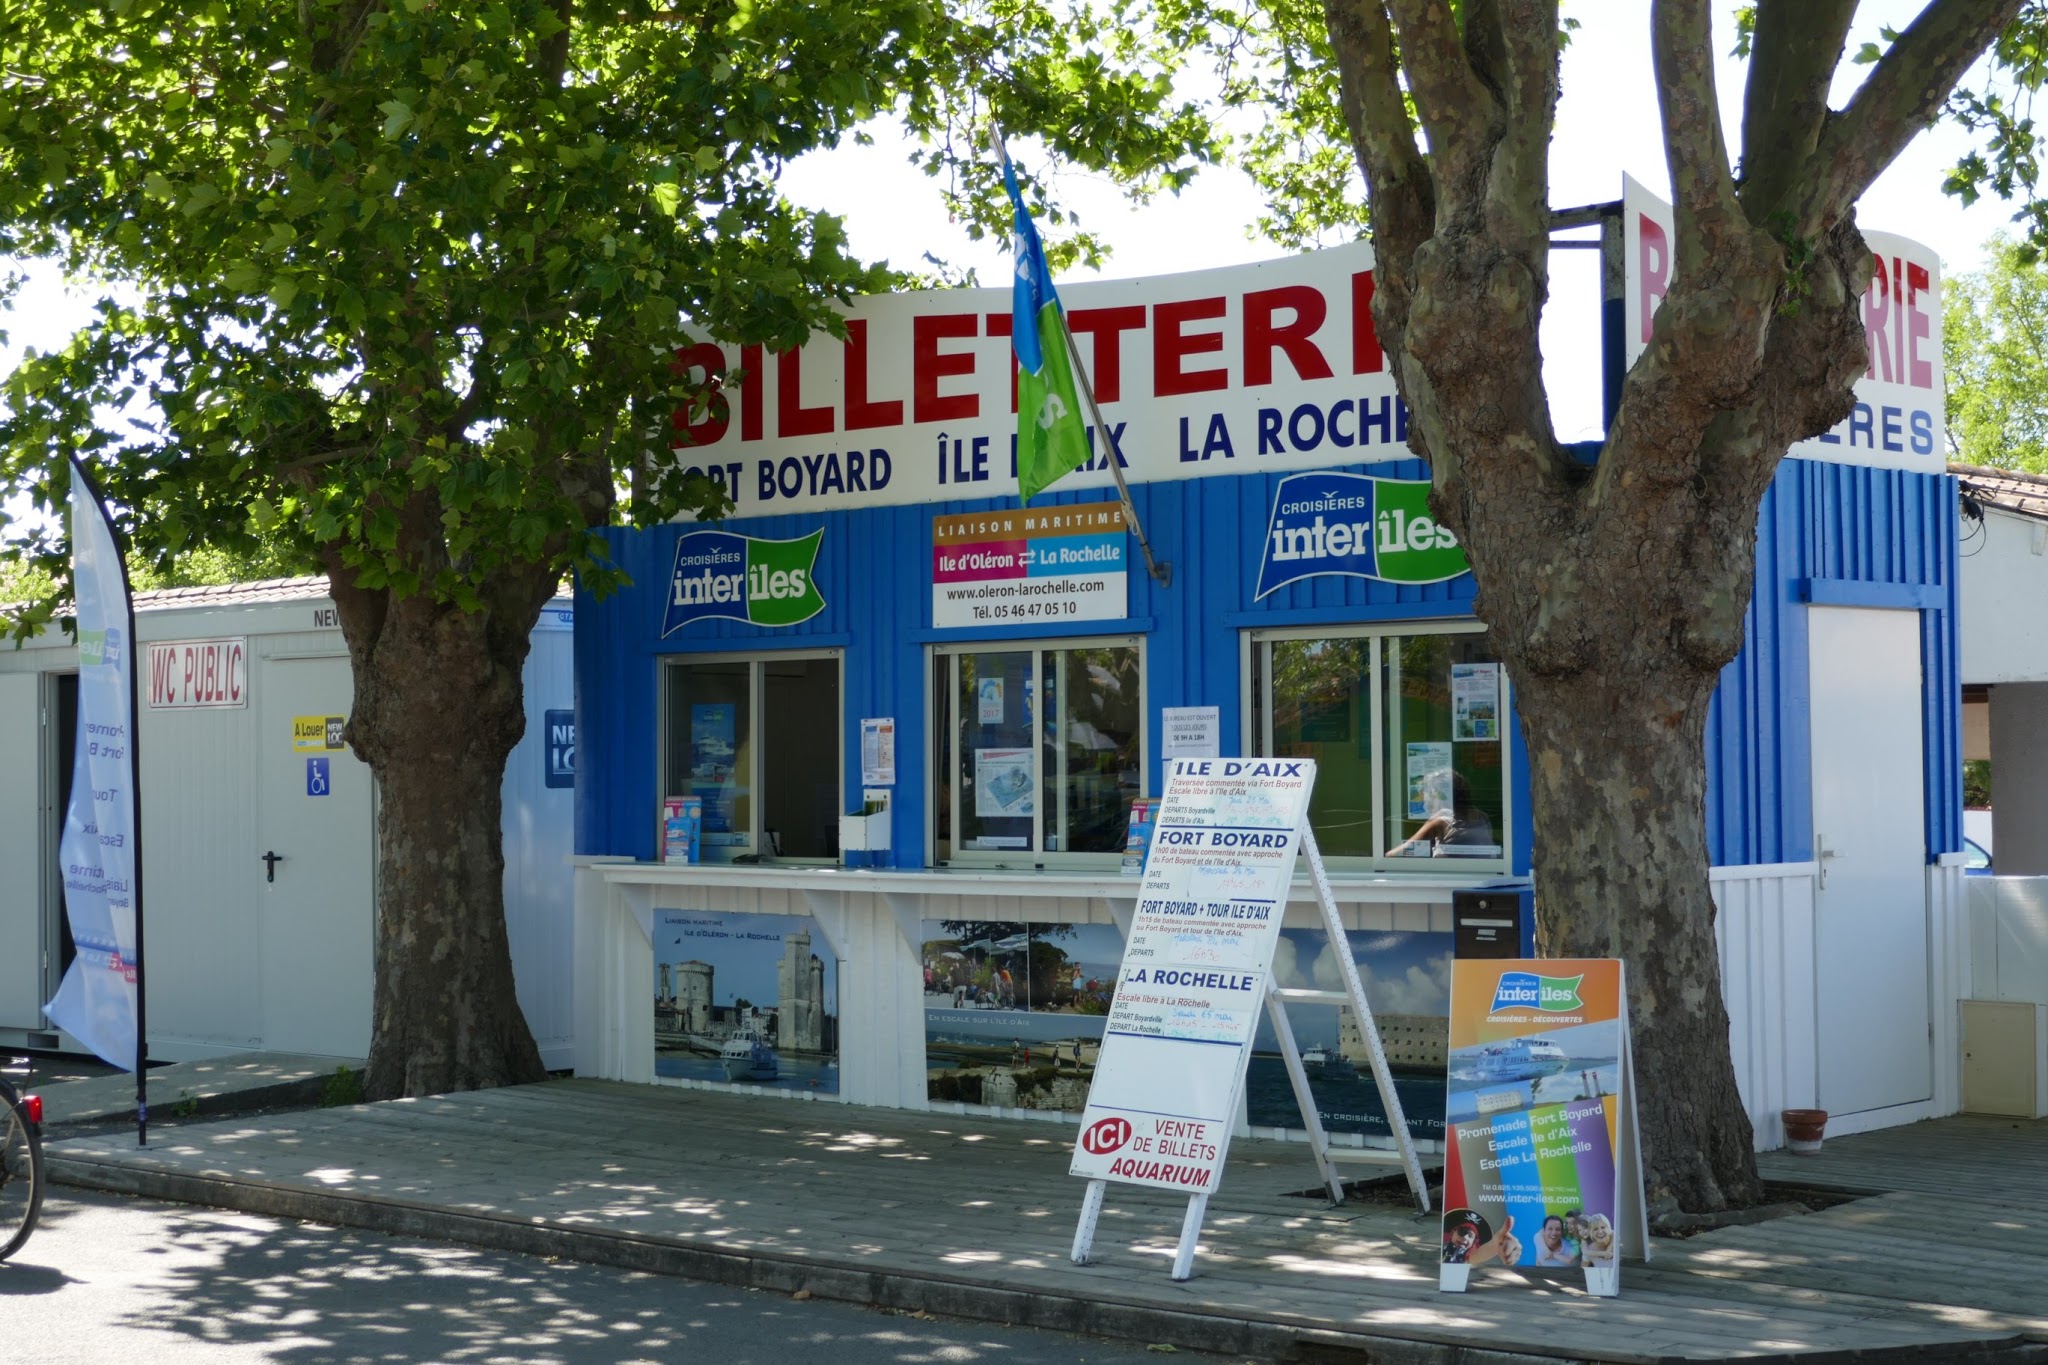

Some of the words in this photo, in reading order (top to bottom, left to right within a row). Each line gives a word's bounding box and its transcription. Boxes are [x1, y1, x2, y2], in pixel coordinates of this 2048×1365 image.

[1180, 413, 1235, 463] LA
[937, 431, 989, 485] ÎLE
[758, 449, 892, 501] BOYARD
[938, 520, 1012, 537] LIAISON
[1025, 511, 1120, 530] MARITIME
[1272, 515, 1370, 561] inter
[1378, 509, 1460, 553] îles
[939, 556, 956, 572] Ile
[958, 551, 1014, 571] d'Oléron
[1040, 549, 1058, 565] La
[1060, 544, 1120, 564] Rochelle
[673, 568, 744, 606] inter
[749, 563, 807, 600] îles
[947, 579, 1104, 600] www.oleron-larochelle.com
[973, 605, 992, 620] Tél.
[994, 605, 1008, 618] 05
[1011, 604, 1025, 617] 46
[1028, 603, 1042, 616] 47
[1045, 602, 1058, 616] 05
[1063, 601, 1076, 614] 10
[152, 648, 176, 704] WC
[184, 644, 241, 703] PUBLIC
[983, 709, 999, 718] 2017
[295, 723, 300, 737] A
[302, 723, 324, 737] Louer
[327, 723, 343, 732] NEW
[327, 732, 343, 744] LOC
[1176, 761, 1212, 776] ILE
[1224, 762, 1302, 777] D'AIX
[1172, 778, 1203, 787] Traversée
[1205, 779, 1246, 787] commentée
[1247, 780, 1258, 788] via
[1259, 780, 1275, 788] Fort
[1275, 780, 1302, 790] Boyard
[1169, 787, 1191, 795] Escale
[1192, 787, 1208, 795] libre
[1229, 787, 1247, 796] d'Aix
[1167, 796, 1179, 804] DATE
[1164, 806, 1188, 814] DEPARTS
[1188, 806, 1215, 815] Boyardville
[1162, 816, 1185, 824] DEPARTS
[1159, 831, 1205, 846] FORT
[1212, 832, 1288, 848] BOYARD
[1155, 847, 1169, 855] 1h00
[1170, 847, 1177, 855] de
[1179, 847, 1199, 856] bateau
[1200, 848, 1236, 857] commentée
[1253, 850, 1283, 859] approche
[1175, 856, 1196, 866] Boyard
[1204, 857, 1212, 865] de
[1149, 870, 1161, 878] DATE
[1146, 882, 1170, 890] DEPARTS
[1141, 900, 1163, 914] FORT
[1164, 901, 1197, 916] BOYARD
[1207, 903, 1230, 917] TOUR
[1231, 905, 1245, 919] ILE
[1246, 905, 1271, 920] D'AIX
[664, 917, 691, 925] LIAISON
[692, 919, 723, 927] MARITIME
[1162, 917, 1182, 925] bateau
[1184, 918, 1220, 927] commentée
[1237, 921, 1267, 930] approche
[1145, 924, 1158, 932] Fort
[1159, 925, 1182, 934] Boyard
[1205, 927, 1213, 935] de
[747, 933, 780, 941] ROCHELLE
[1133, 936, 1145, 944] DATE
[1131, 948, 1154, 957] DEPARTS
[1153, 970, 1253, 991] ROCHELLE
[1498, 986, 1538, 1001] inter
[1541, 986, 1573, 1001] îles
[1115, 1002, 1128, 1010] DATE
[1117, 993, 1141, 1002] Escale
[1142, 994, 1159, 1004] libre
[1160, 996, 1165, 1004] à
[1167, 996, 1176, 1005] La
[1178, 997, 1210, 1008] Rochelle
[941, 1015, 970, 1024] ESCALE
[972, 1016, 988, 1025] SUR
[1112, 1011, 1133, 1021] DEPART
[1134, 1014, 1163, 1024] Boyardville
[1533, 1015, 1583, 1023] DÉCOUVERTES
[1110, 1023, 1131, 1032] DEPART
[1138, 1025, 1161, 1035] Rochelle
[1458, 1118, 1528, 1140] Promenade
[1529, 1114, 1556, 1127] Fort
[1559, 1104, 1603, 1122] Boyard
[1089, 1121, 1125, 1151] ICI
[1155, 1119, 1206, 1140] VENTE
[1488, 1135, 1528, 1152] Escale
[1531, 1132, 1545, 1144] Ile
[1547, 1127, 1577, 1141] d'Aix
[1133, 1136, 1153, 1152] DE
[1158, 1139, 1216, 1160] BILLETS
[1480, 1156, 1519, 1170] Escale
[1522, 1151, 1537, 1163] La
[1540, 1141, 1592, 1159] Rochelle
[1108, 1157, 1211, 1187] AQUARIUM
[1479, 1193, 1579, 1205] www.inter-iles.com
